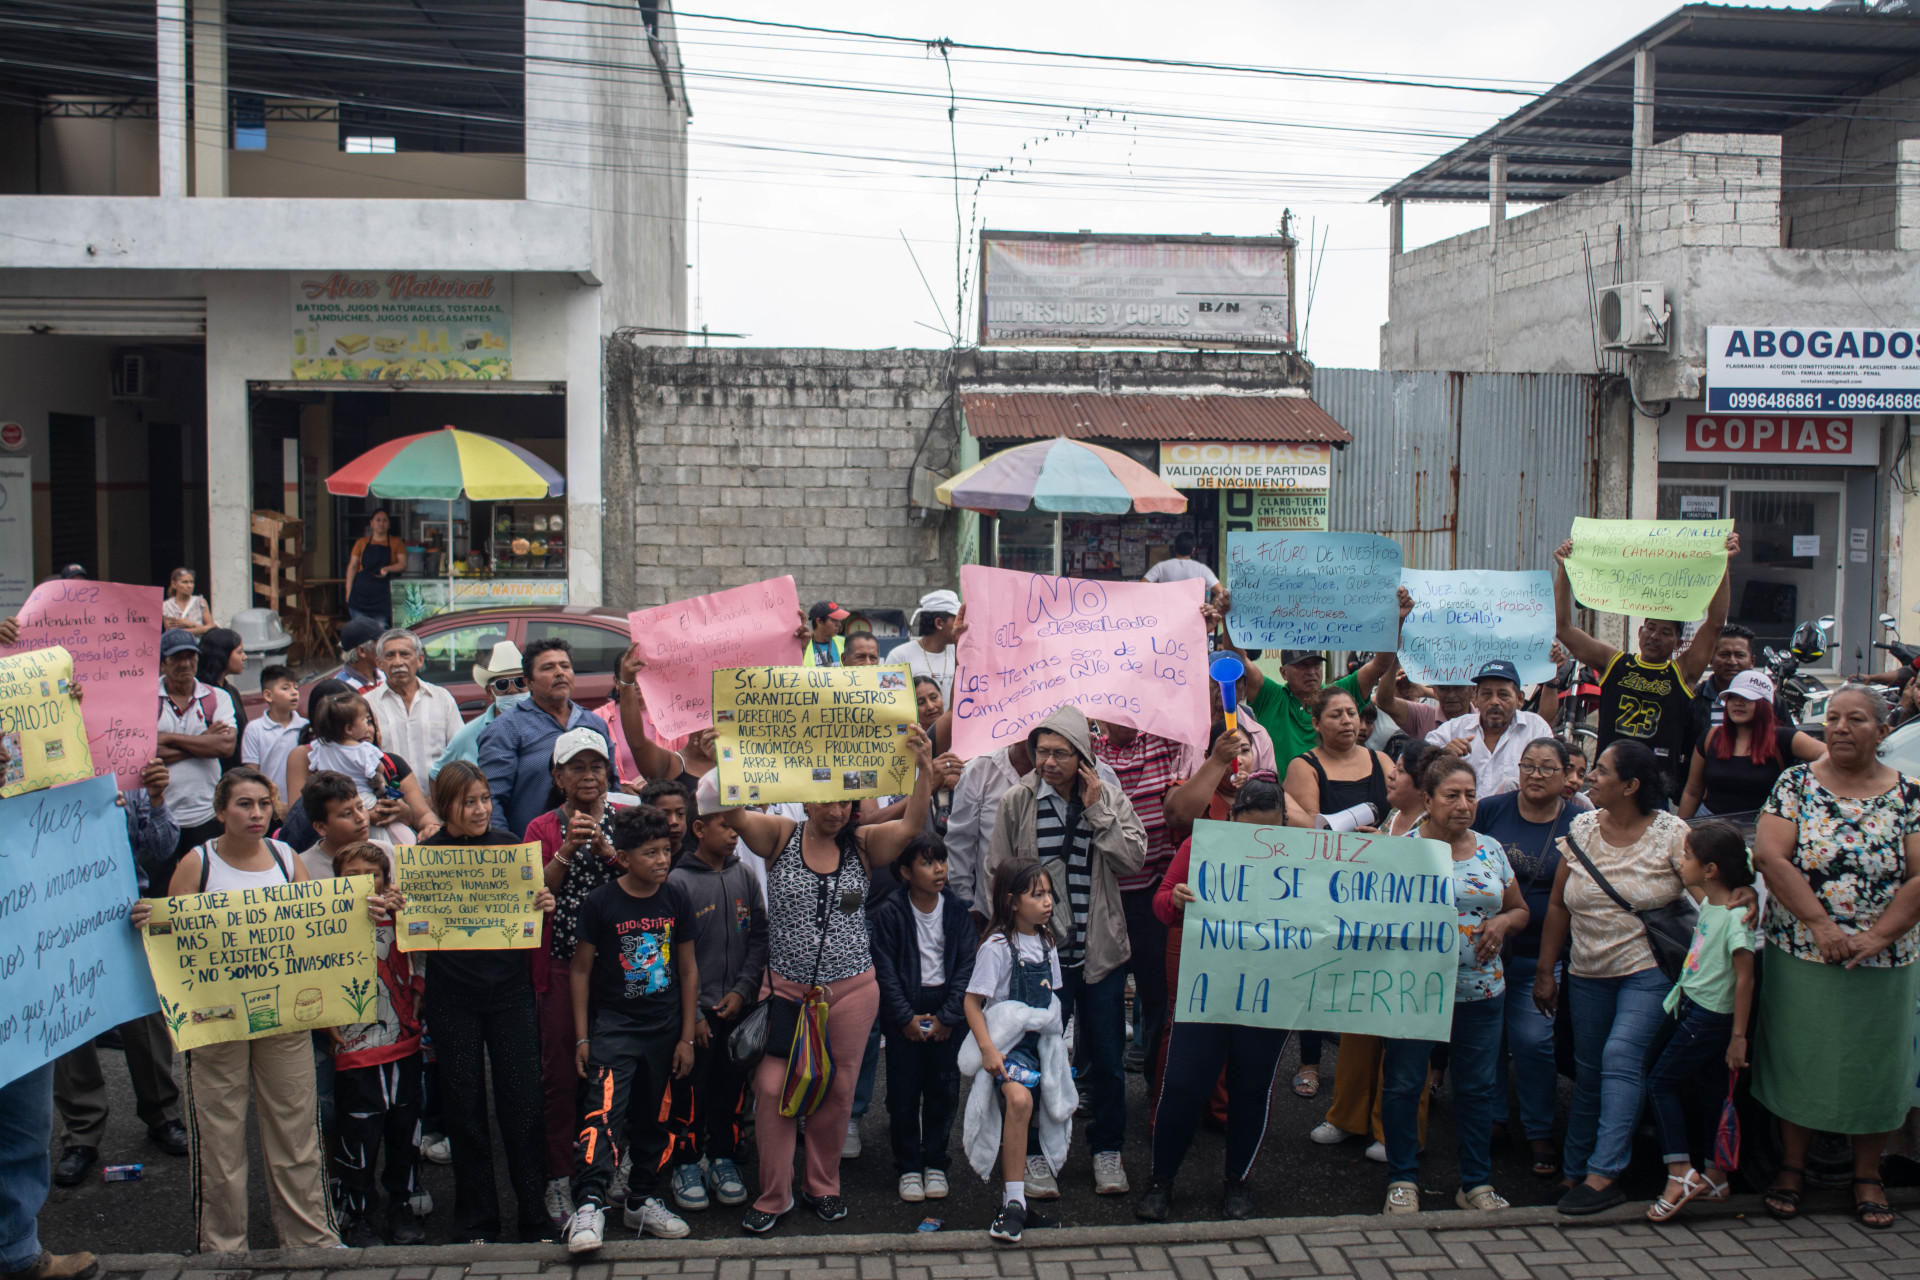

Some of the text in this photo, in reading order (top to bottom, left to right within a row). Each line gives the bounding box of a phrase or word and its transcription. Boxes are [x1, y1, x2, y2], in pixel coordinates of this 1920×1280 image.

[302, 272, 495, 299] Alex Natural
[296, 304, 504, 314] BATIDOS, JUGOS NATURALES, TOSTADAS,
[989, 302, 1190, 326] IMPRESIONES Y COPIAS
[1199, 302, 1240, 313] B/N
[309, 314, 492, 323] SANDUCHES, JUGOS ADELGASANTES
[1725, 330, 1920, 359] ABOGADO
[1728, 393, 1823, 408] 0996486861
[1695, 418, 1848, 451] COPIAS
[1171, 444, 1321, 463] COPIAS
[1166, 464, 1327, 476] VALIDACIÓN DE PARTIDAS
[1197, 477, 1296, 488] DE NACIMIENTO
[1257, 516, 1319, 527] IMPRESIONES
[1232, 546, 1250, 563] EL
[1257, 539, 1308, 563] FUTURO
[1608, 569, 1624, 584] 30
[52, 582, 100, 603] Juez
[492, 583, 563, 596] NATURALES
[1027, 573, 1107, 623] NO
[1230, 615, 1245, 630] EL
[23, 665, 47, 679] QUE
[960, 666, 989, 693] Las
[1114, 641, 1137, 657] de
[1070, 659, 1110, 680] NO
[1120, 659, 1143, 672] de
[735, 667, 863, 690] Sr. JUEZ QUE SE
[1749, 677, 1772, 692] HUGO
[736, 690, 896, 706] GARANTICEN NUESTROS
[738, 707, 876, 724] DERECHOS A EJERCER
[1615, 694, 1662, 738] 23
[738, 723, 893, 739] NUESTRAS ACTIVIDADES
[825, 740, 896, 755] PRODUCIMOS
[742, 754, 907, 769] ARROZ PARA EL MERCADO DE
[29, 798, 88, 858] Juez
[400, 847, 517, 866] LA CONSTITUCION
[1305, 830, 1373, 863] JUEZ
[45, 856, 117, 902] invasores
[492, 868, 507, 878] DE
[1198, 859, 1254, 904] QUE
[1269, 865, 1306, 900] SE
[462, 880, 510, 890] HUMANOS
[168, 896, 190, 916] Sr.
[193, 893, 229, 911] JUEZ
[243, 889, 260, 905] EL
[334, 877, 354, 895] LA
[469, 892, 520, 902] NUESTROS
[227, 911, 243, 927] DE
[246, 908, 268, 925] LOS
[274, 901, 326, 921] ANGELES
[332, 897, 355, 914] CON
[458, 903, 520, 914] QUE VIOLA
[222, 931, 238, 948] DE
[249, 925, 295, 945] MEDIO
[306, 918, 347, 938] SIGLO
[1199, 915, 1455, 953] NUESTRO DERECHO
[179, 944, 295, 969] DE EXISTENCIA
[199, 951, 355, 983] NO SOMOS INVASORES
[69, 958, 108, 999] haga
[1189, 957, 1444, 1015] A LA TIERRA
